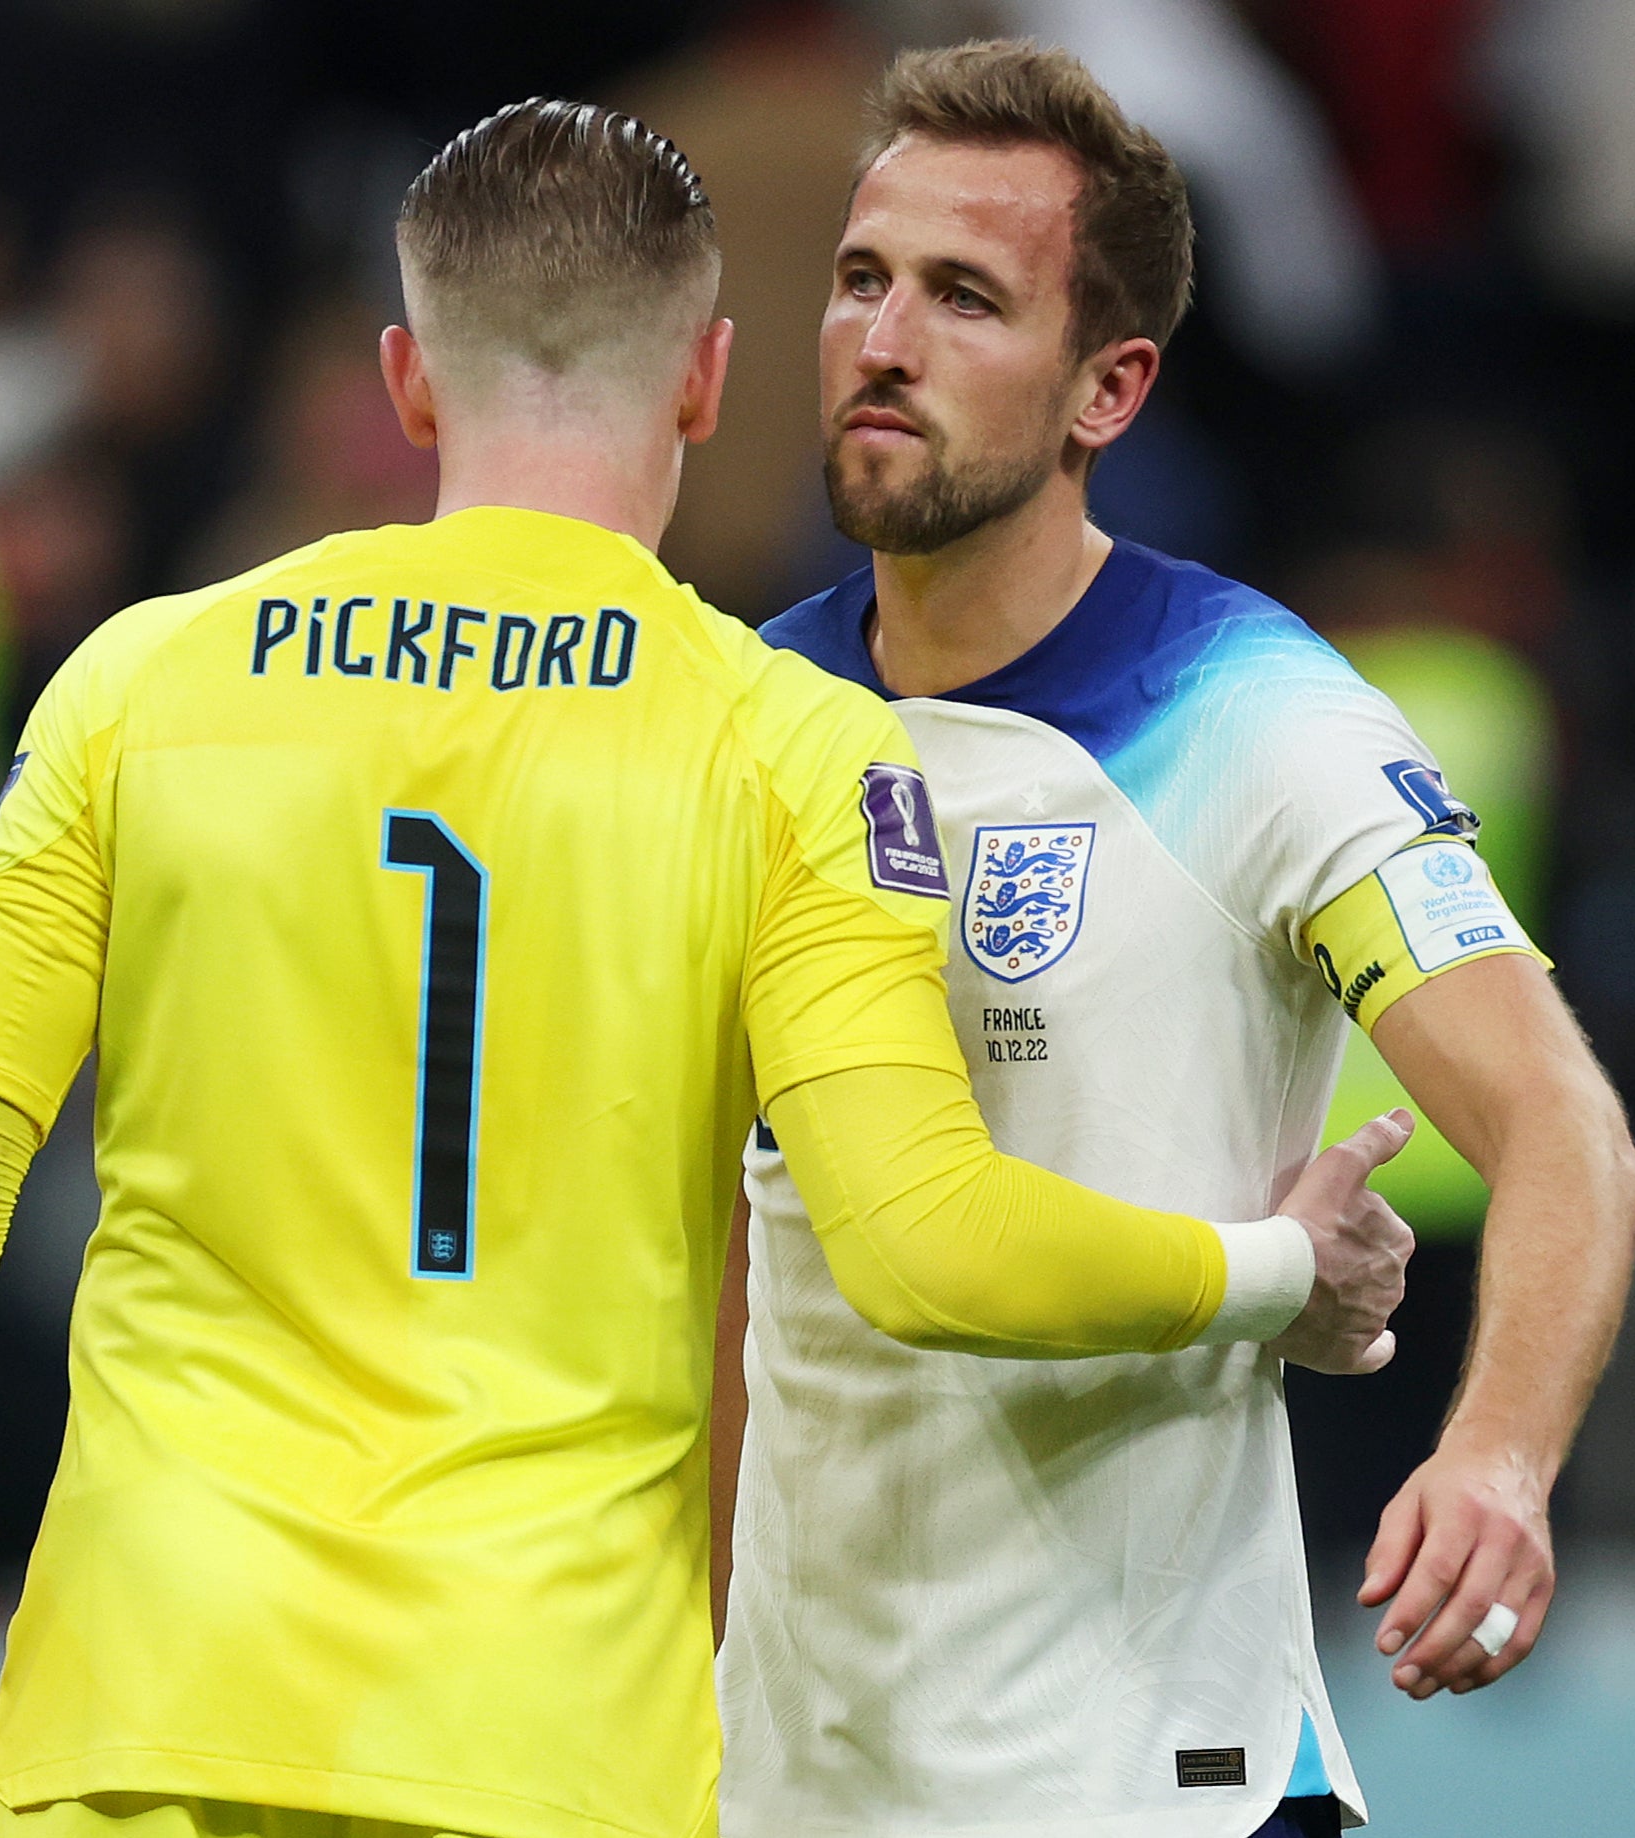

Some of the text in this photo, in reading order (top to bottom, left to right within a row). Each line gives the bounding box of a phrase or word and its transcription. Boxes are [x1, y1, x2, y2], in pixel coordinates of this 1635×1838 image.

[1421, 890, 1458, 909] World
[1462, 927, 1499, 943] FIFA
[983, 1008, 1046, 1031] FRANCE
[380, 807, 490, 1281] 1
[985, 1038, 1048, 1062] 10.12.22
